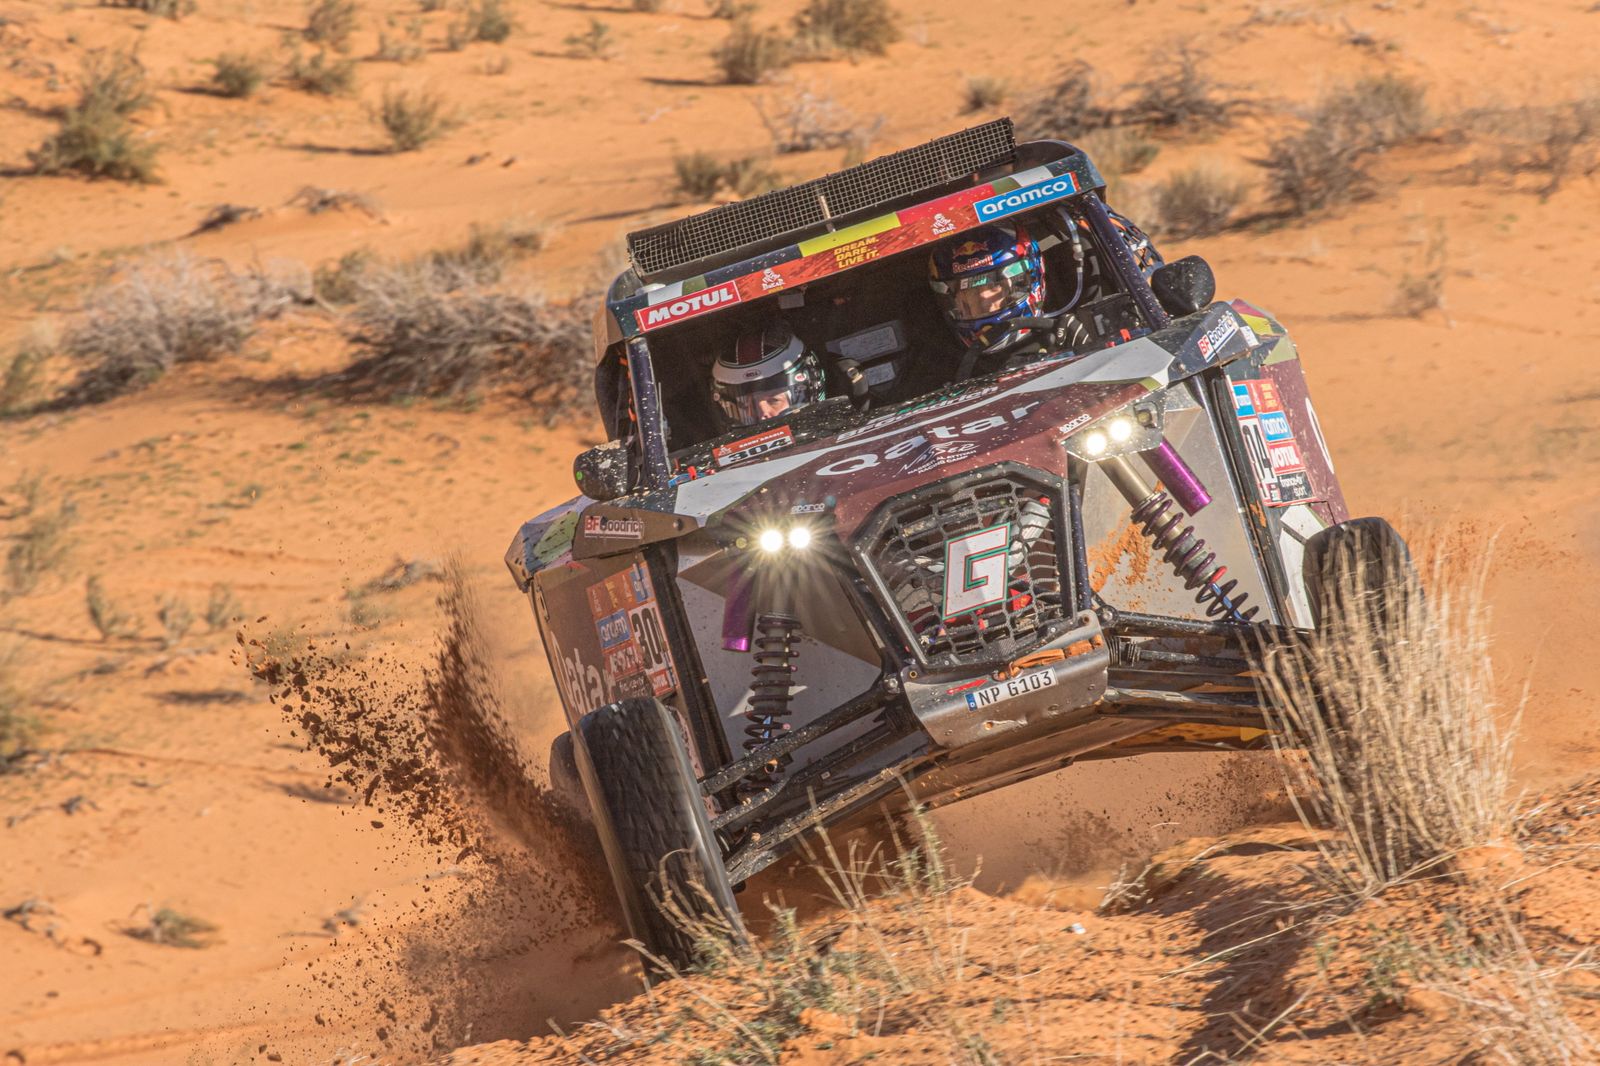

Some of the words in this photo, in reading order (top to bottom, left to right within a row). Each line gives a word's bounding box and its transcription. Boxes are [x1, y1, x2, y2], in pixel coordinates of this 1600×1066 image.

[981, 181, 1068, 215] aramco
[834, 236, 879, 255] DREAM.
[836, 246, 872, 261] DARE.
[838, 254, 864, 268] LIVE
[866, 250, 880, 260] IT.
[648, 288, 733, 324] MOTUL
[1059, 414, 1092, 434] sparco
[815, 401, 1040, 476] Qatar
[728, 438, 788, 462] 304
[978, 687, 1000, 706] NP
